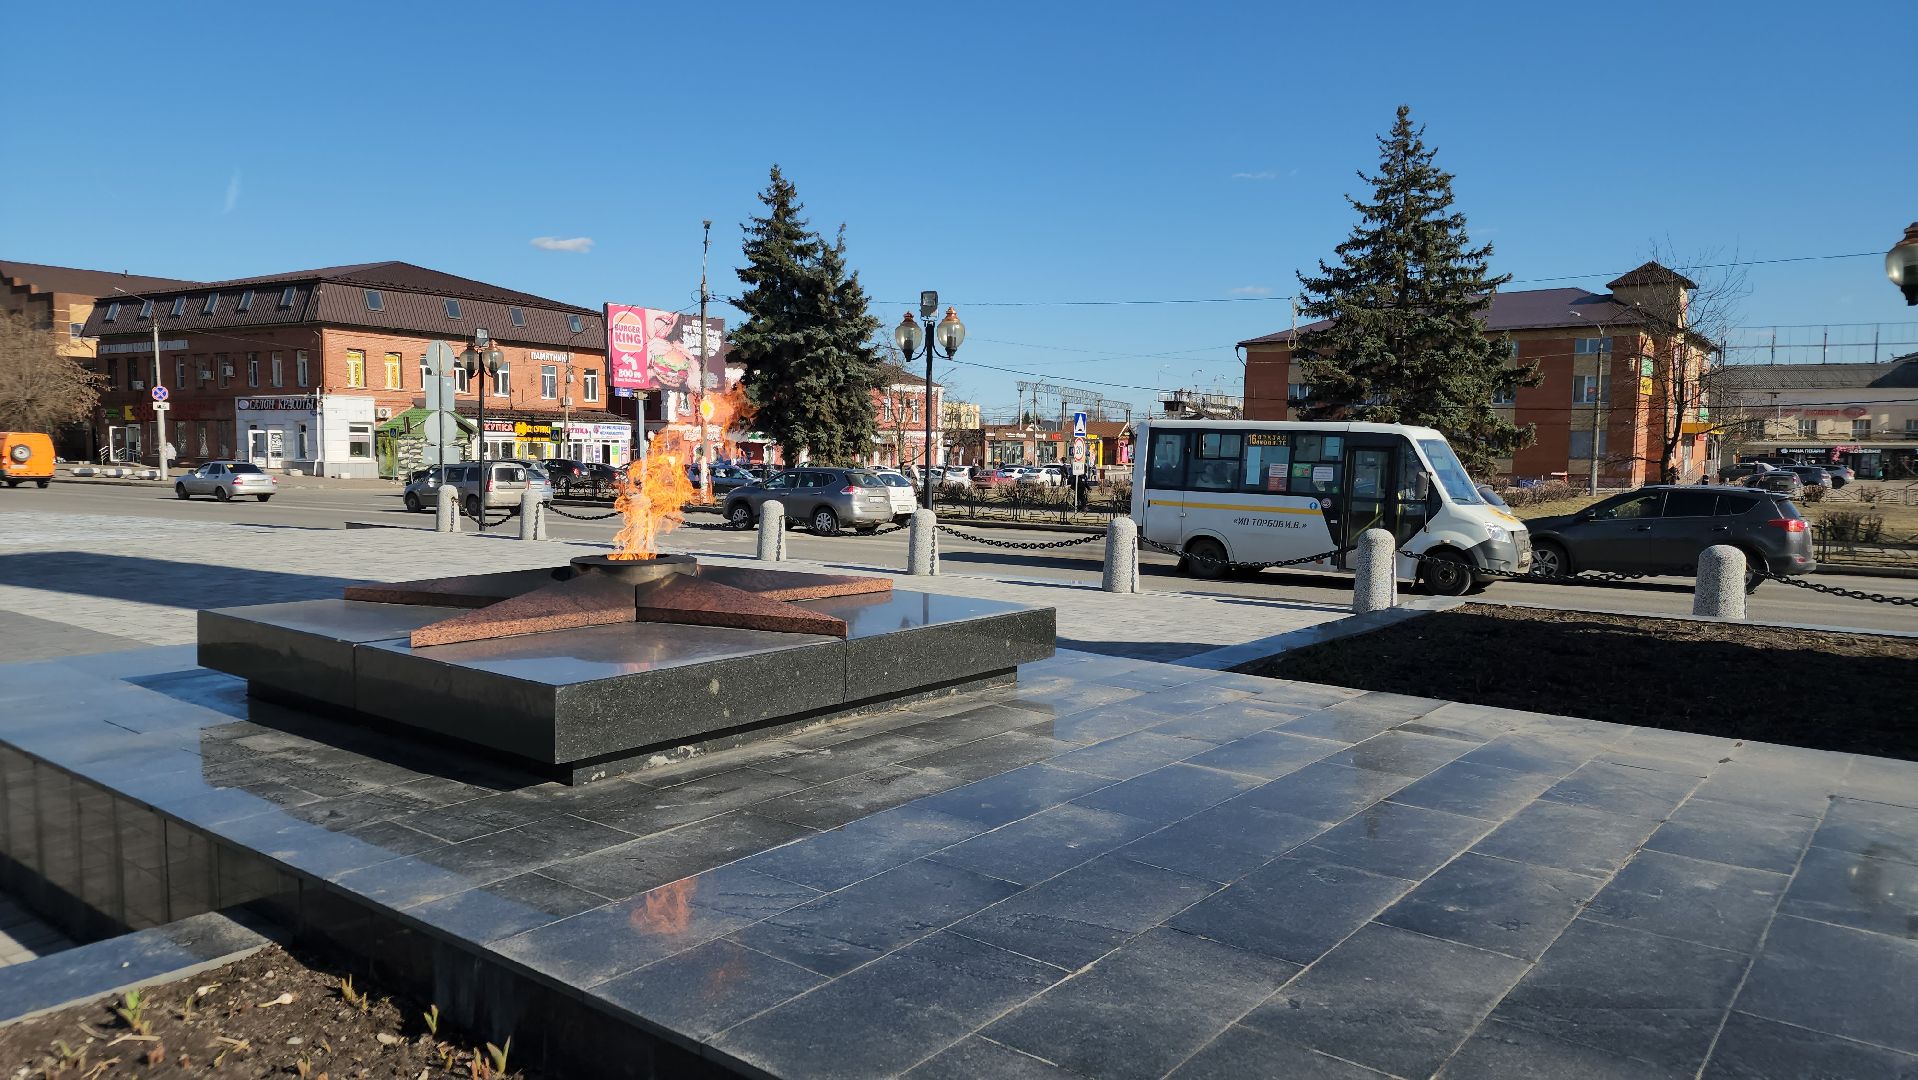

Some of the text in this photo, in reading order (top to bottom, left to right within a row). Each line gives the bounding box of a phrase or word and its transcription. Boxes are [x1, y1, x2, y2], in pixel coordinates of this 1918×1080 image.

[614, 323, 641, 335] BURGER
[615, 332, 642, 345] KING
[249, 398, 315, 410] САЛОН КРАСОТЫ
[1248, 434, 1257, 445] 16
[1252, 518, 1284, 528] ТОРБОВ
